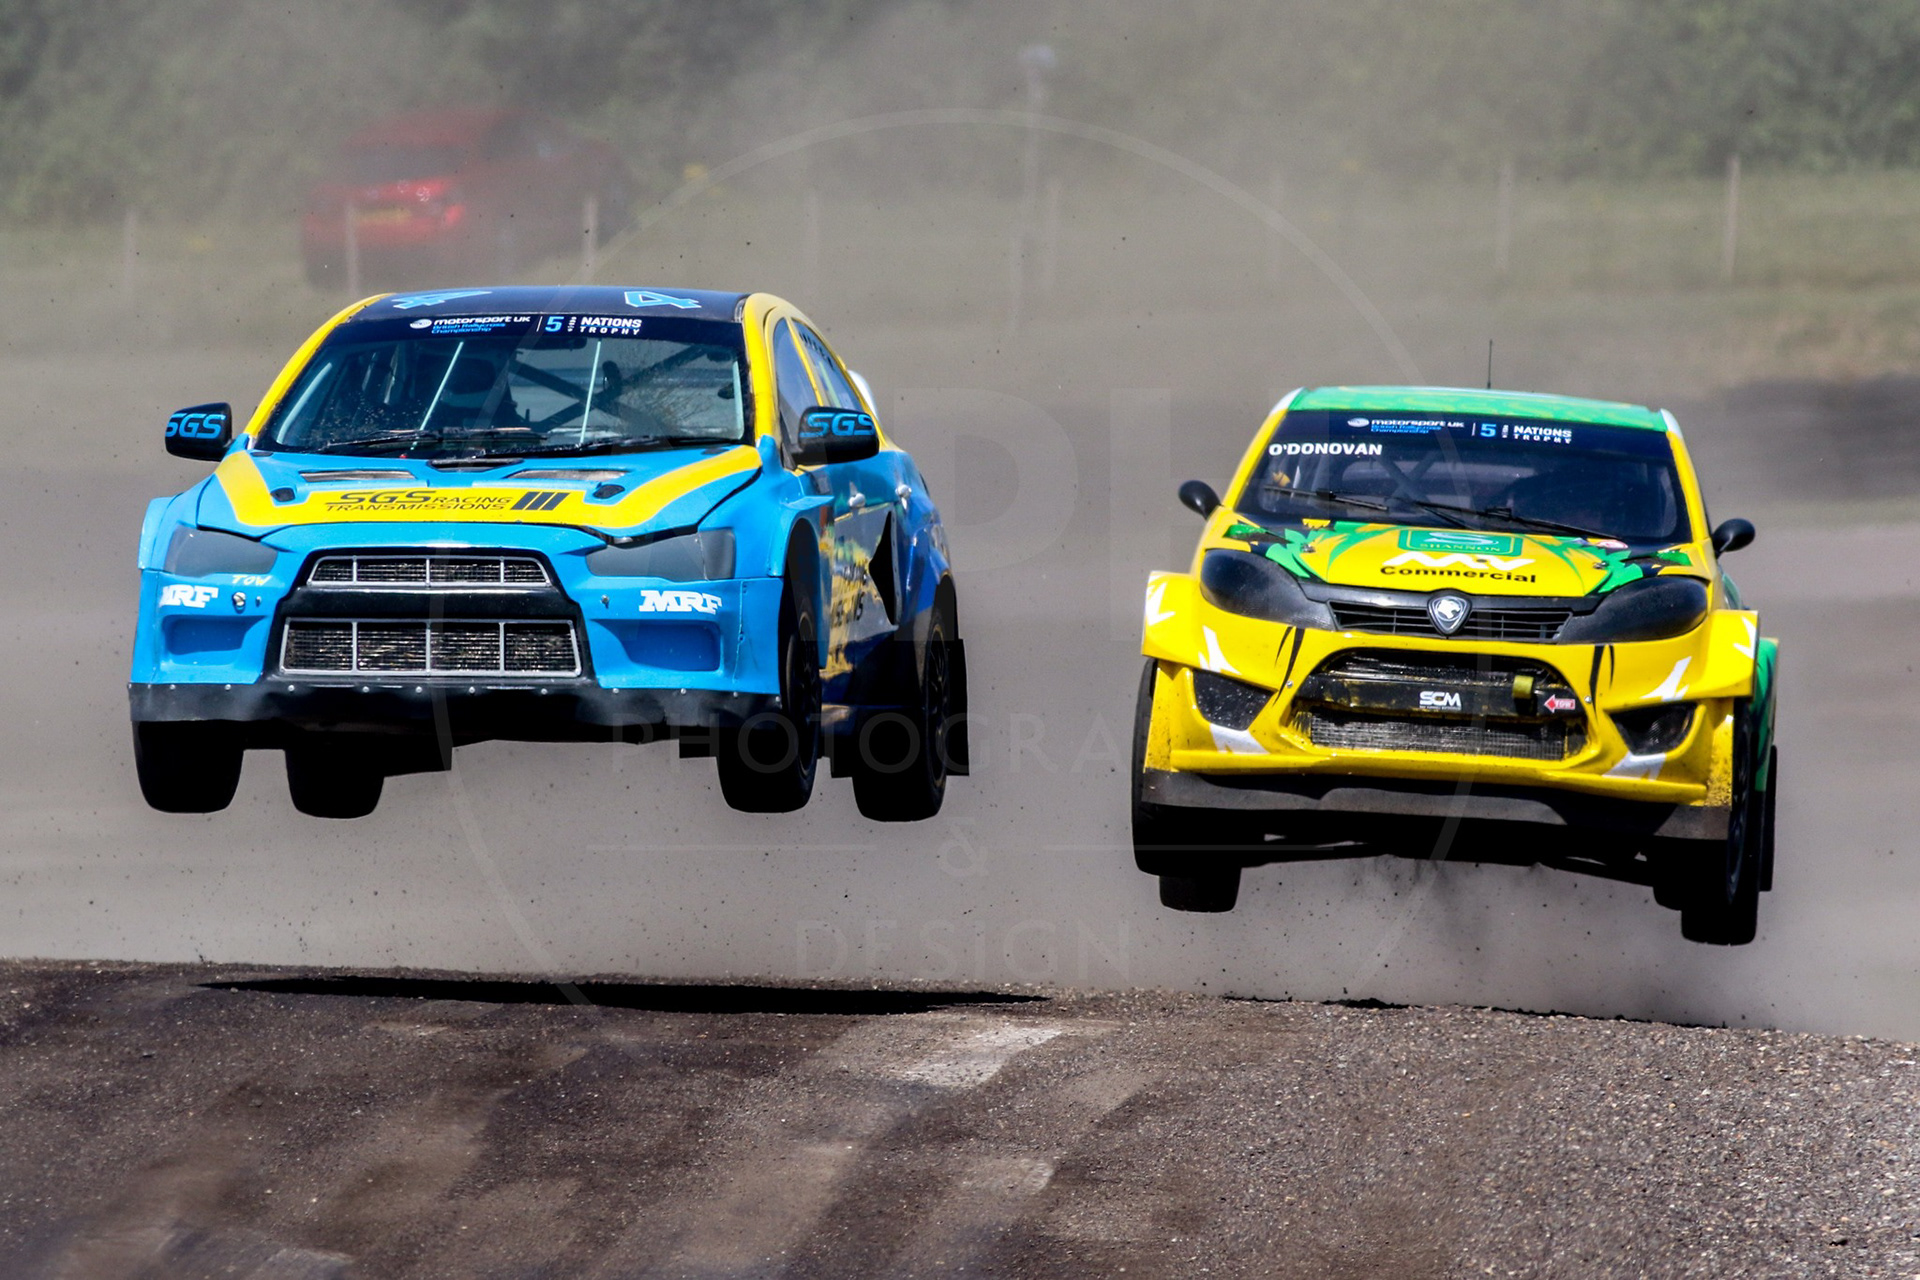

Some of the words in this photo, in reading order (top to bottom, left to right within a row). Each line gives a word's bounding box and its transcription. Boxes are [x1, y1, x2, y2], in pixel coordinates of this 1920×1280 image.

[623, 290, 701, 309] 4
[434, 315, 512, 326] motorsport
[545, 316, 564, 332] 5
[581, 316, 642, 328] NATIONS
[580, 326, 640, 335] TROPHY
[165, 413, 226, 439] SGS
[800, 412, 875, 436] SGS
[1371, 419, 1446, 427] motorsport
[1480, 423, 1497, 437] 5
[1513, 425, 1572, 438] NATIONS
[1513, 433, 1571, 444] TROPHY
[1269, 442, 1383, 456] O'DONOVAN
[326, 490, 437, 505] SGS
[432, 496, 513, 504] RACING
[326, 504, 505, 512] TRANSMISSIONS
[1419, 543, 1501, 552] SHANNON
[231, 575, 273, 587] TOW
[1380, 566, 1537, 583] Commercial
[639, 590, 722, 615] MRF
[1419, 690, 1462, 706] SCM
